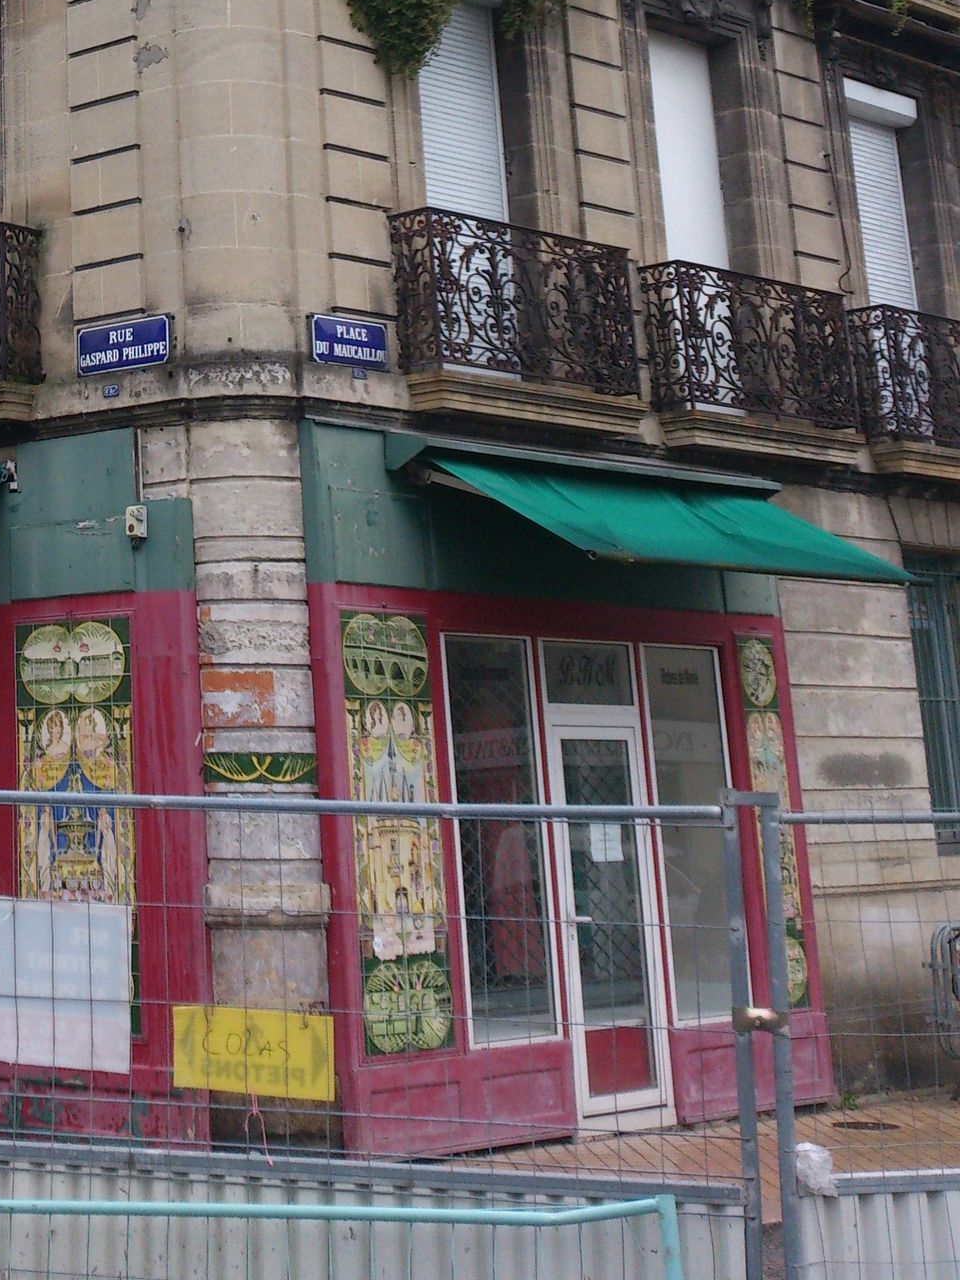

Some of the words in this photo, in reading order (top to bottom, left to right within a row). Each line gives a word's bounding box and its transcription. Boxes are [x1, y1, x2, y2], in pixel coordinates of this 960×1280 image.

[109, 327, 133, 344] RUE
[336, 324, 368, 341] PLACE
[80, 348, 119, 368] GASPARD
[122, 341, 166, 361] PHILIPPE
[316, 340, 329, 354] DU
[333, 342, 388, 363] MAUCAILLOU
